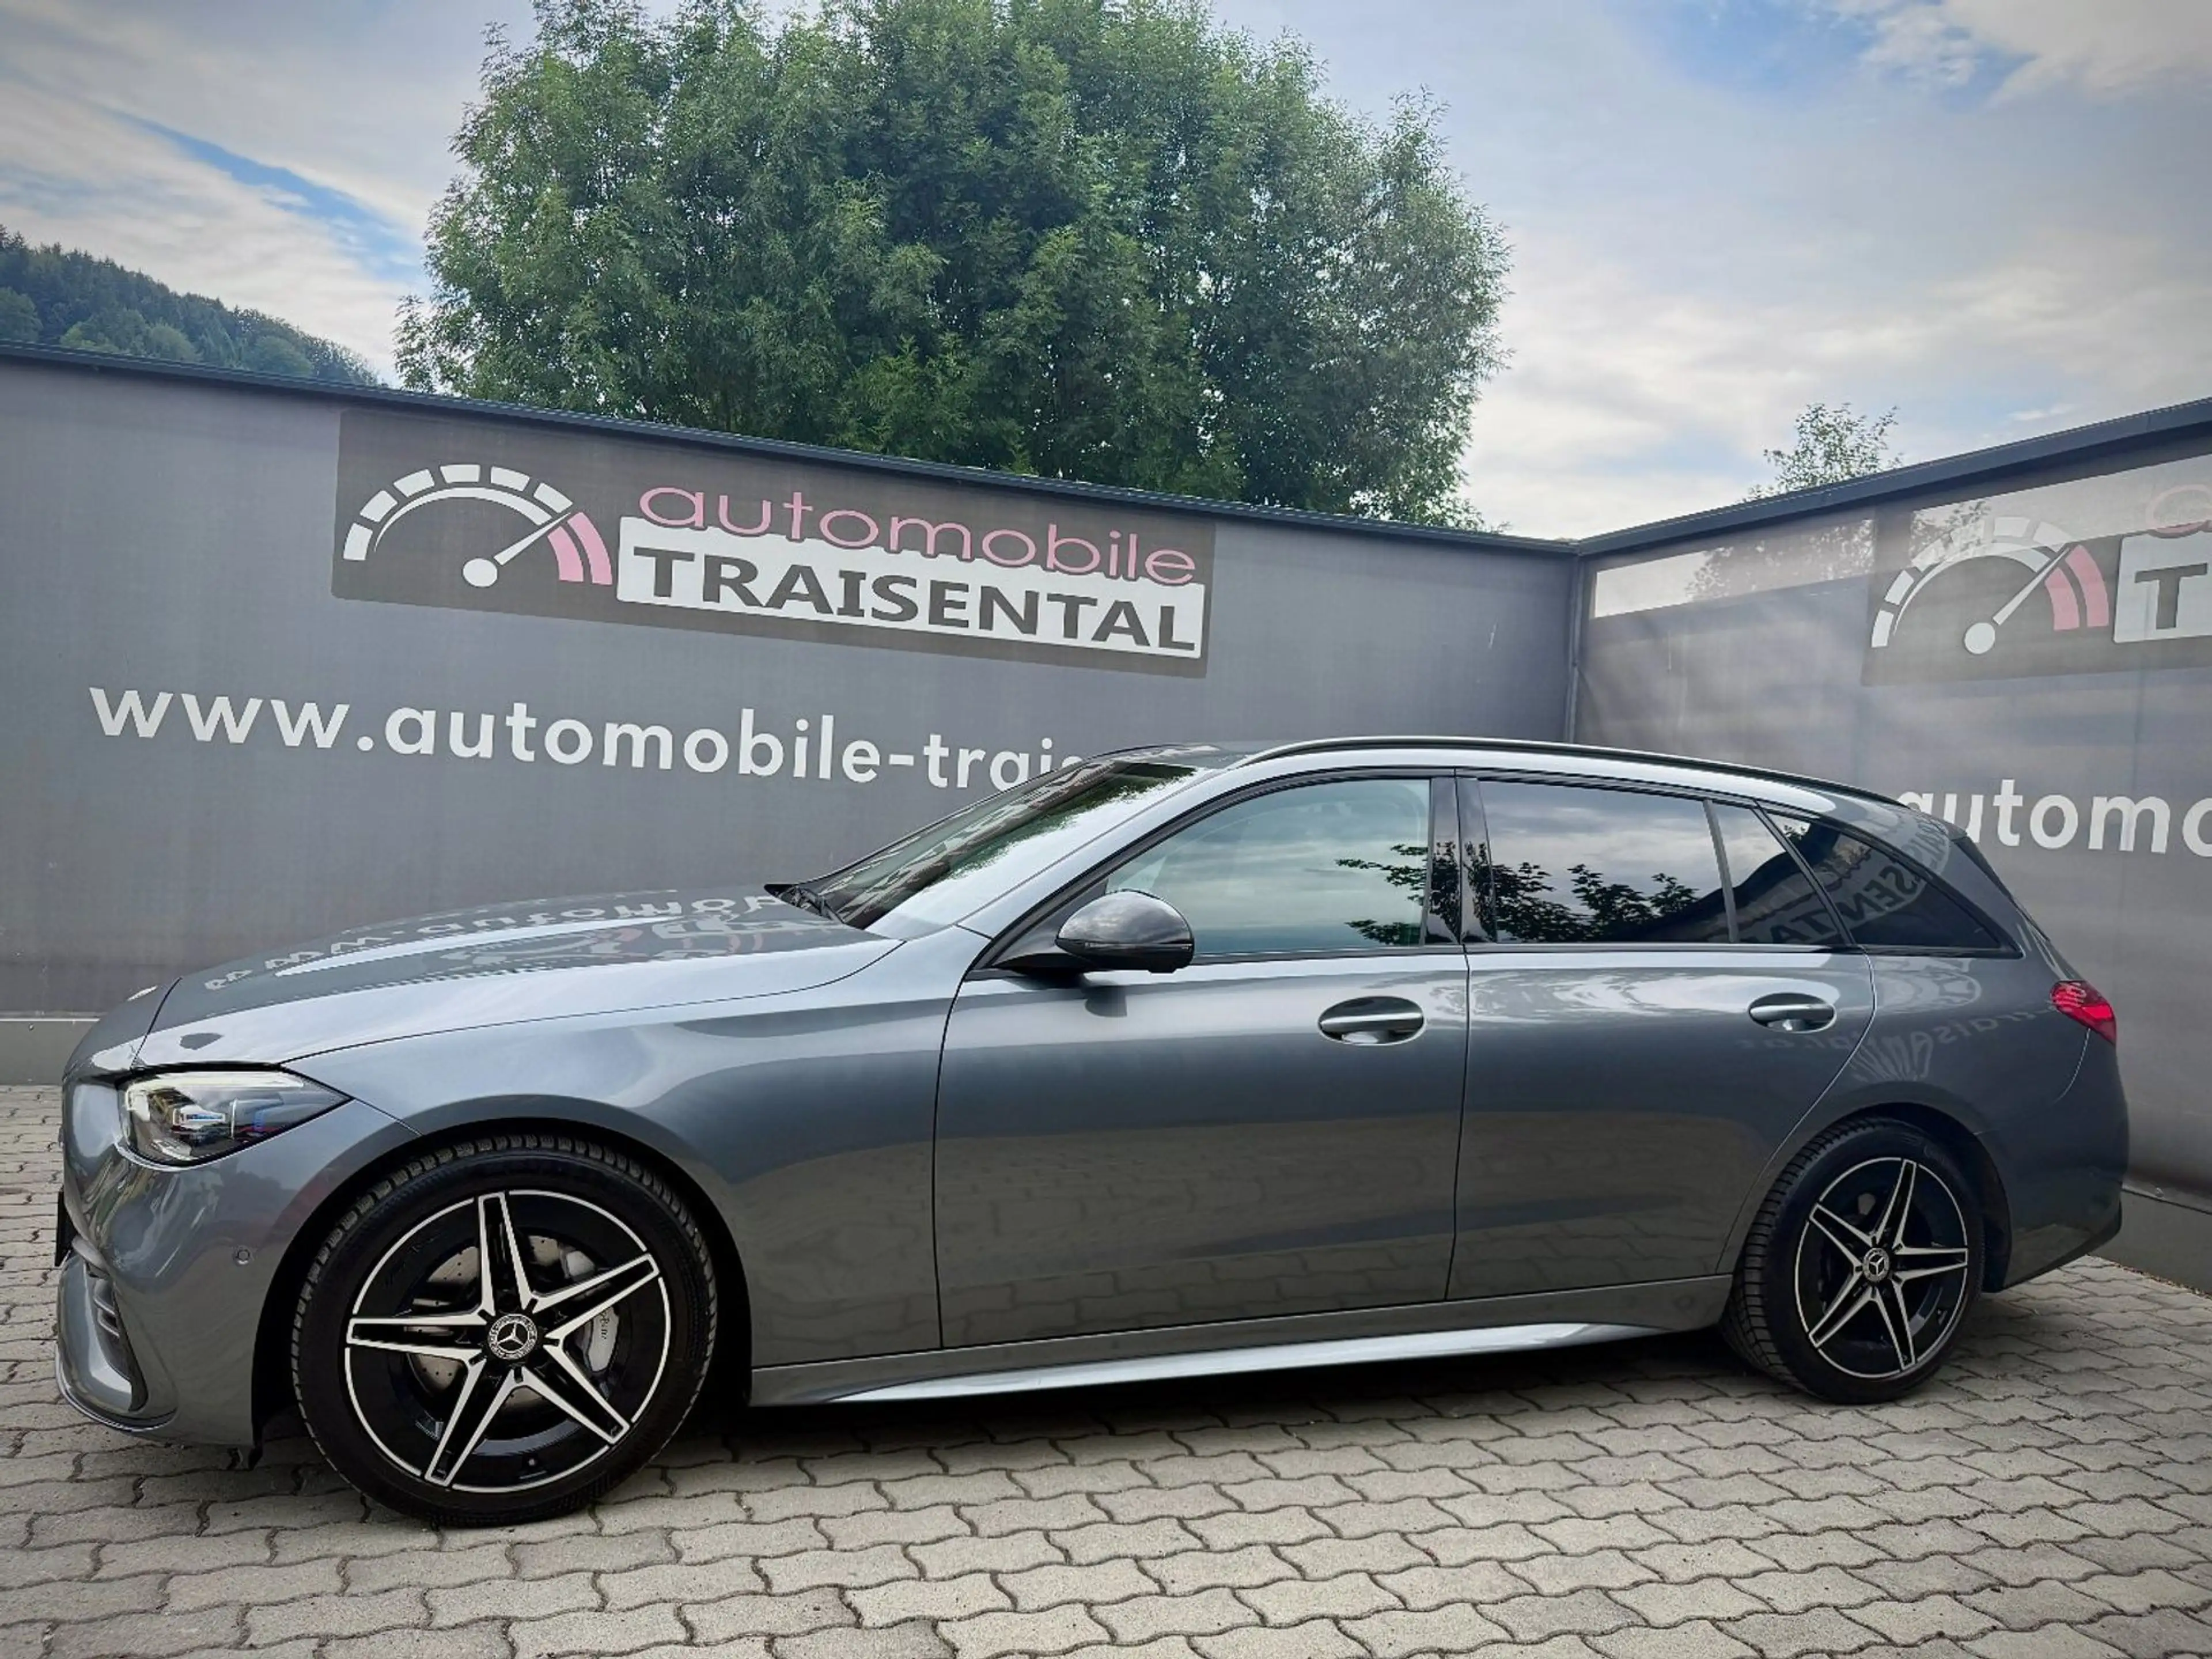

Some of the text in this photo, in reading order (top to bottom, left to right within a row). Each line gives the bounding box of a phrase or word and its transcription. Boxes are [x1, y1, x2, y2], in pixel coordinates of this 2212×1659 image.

[639, 487, 1197, 585] automobile
[633, 546, 1195, 652] TRAISENTAL
[89, 687, 1083, 791] www.automobile-trai
